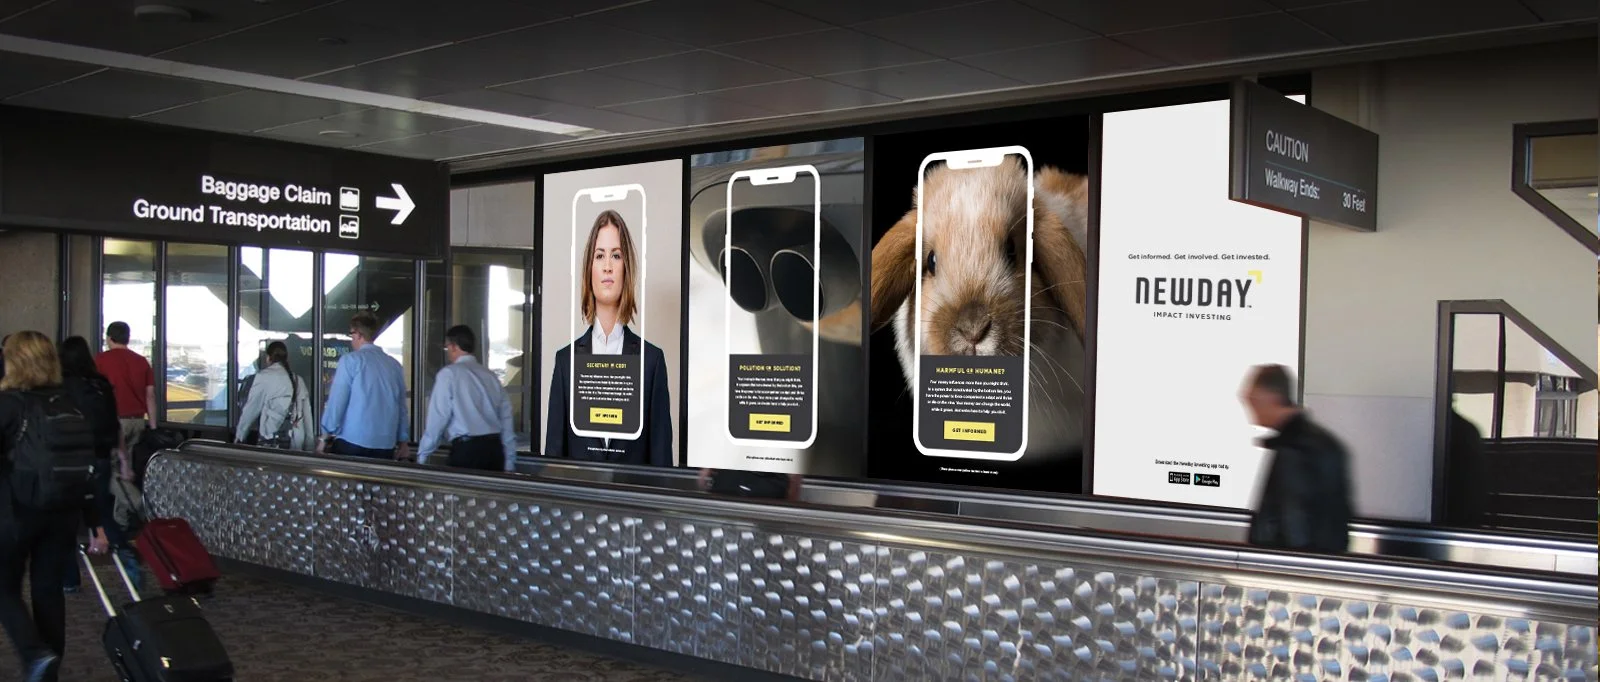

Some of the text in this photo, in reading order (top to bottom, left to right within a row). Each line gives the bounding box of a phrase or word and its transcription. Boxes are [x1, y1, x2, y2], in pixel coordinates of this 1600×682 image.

[1265, 130, 1309, 163] CAUTION
[201, 175, 332, 205] Baggage Claim
[1264, 168, 1320, 200] Walkway Ends:
[133, 199, 331, 233] Ground Transportation
[1342, 192, 1366, 212] 30 Feet
[1153, 311, 1231, 321] IMPACT INVESTING
